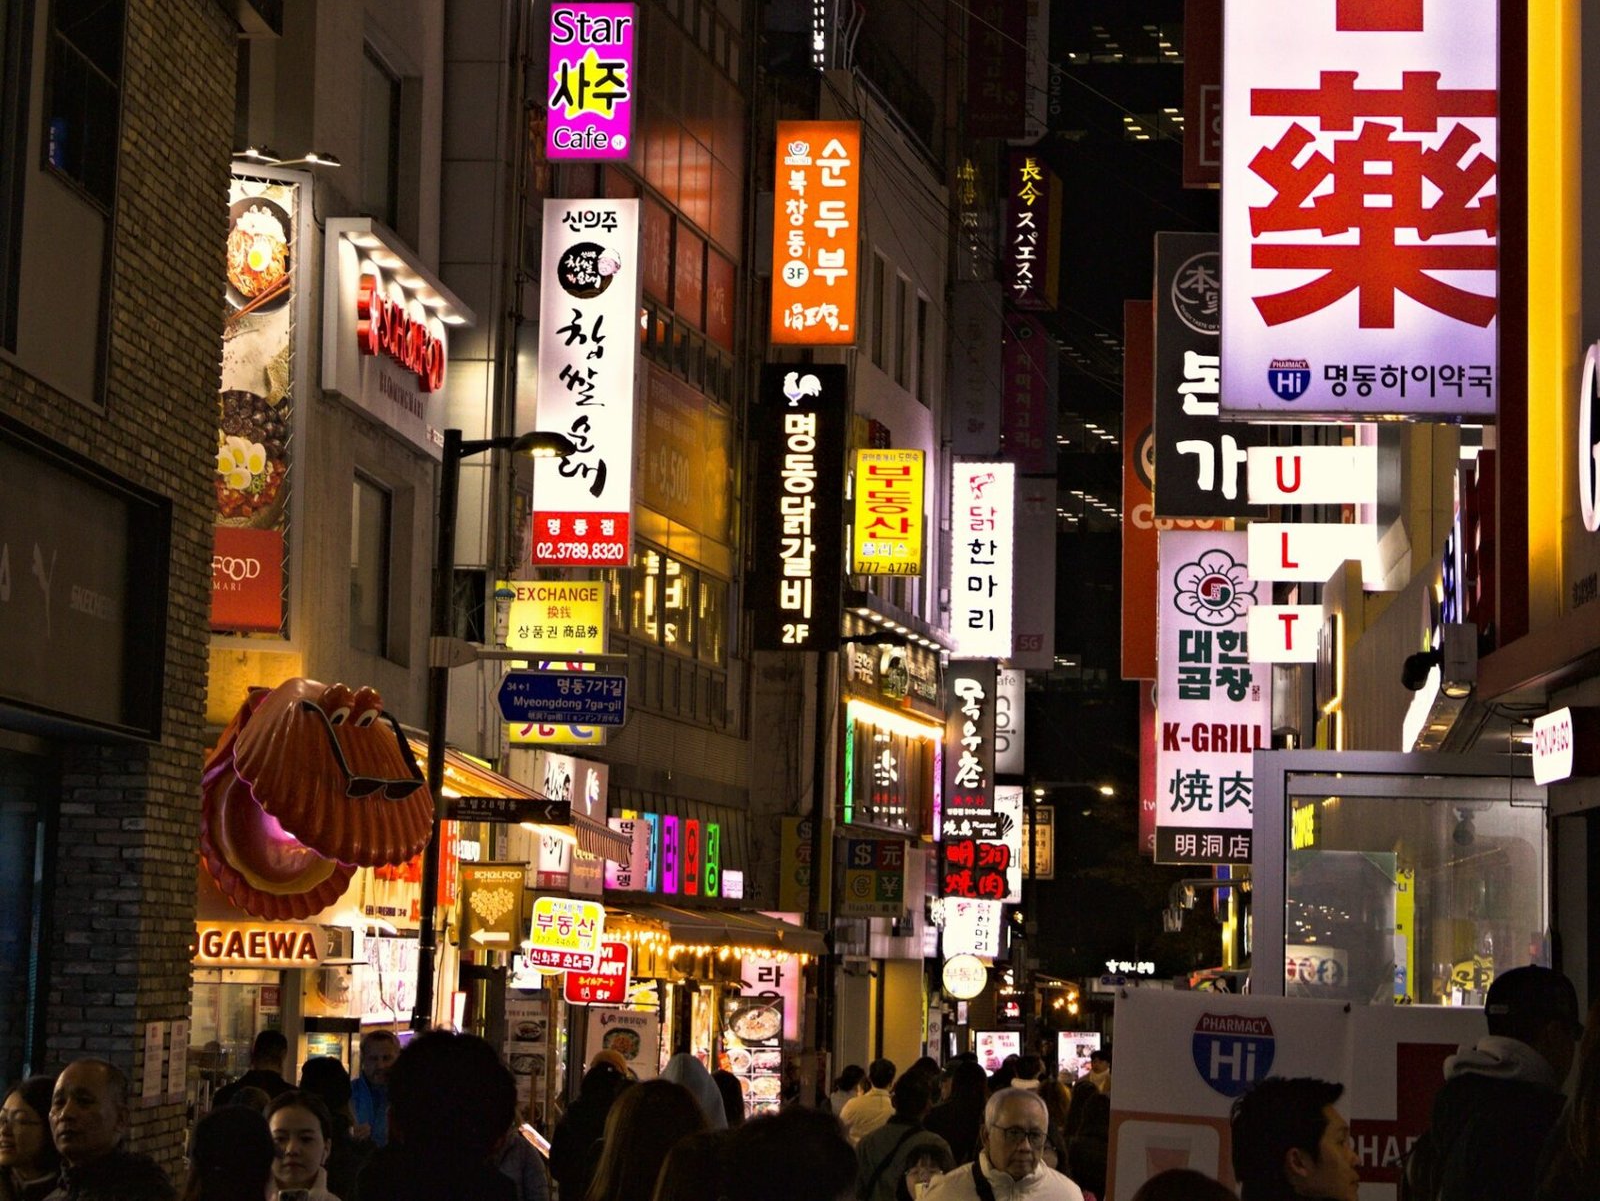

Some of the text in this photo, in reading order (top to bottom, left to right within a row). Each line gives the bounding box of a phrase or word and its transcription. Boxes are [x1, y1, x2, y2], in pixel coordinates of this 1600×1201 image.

[552, 10, 631, 44] Star
[551, 61, 628, 110] 사주
[554, 126, 608, 149] Cafe
[1017, 157, 1044, 207] 長今
[562, 210, 618, 233] 신의주
[785, 169, 809, 258] 북창동
[813, 138, 851, 287] 순두부
[787, 267, 805, 280] 3F
[1273, 361, 1307, 369] PHARMACY
[1277, 372, 1302, 393] Hi
[1323, 363, 1493, 398] 명동하이약국
[864, 465, 914, 541] 부동산
[546, 518, 615, 536] 명동점
[779, 412, 818, 619] 명동닭갈비
[536, 542, 624, 561] 02.3789.8320
[858, 562, 918, 575] 777-4778
[967, 505, 999, 632] 닭한마리
[516, 587, 598, 602] EXCHANGE
[518, 625, 598, 639] 상품권 商品券
[781, 624, 810, 644] 2F
[1019, 635, 1039, 649] 5G
[1178, 629, 1248, 665] 대한
[557, 678, 623, 697] 명동7가길
[1178, 666, 1253, 703] 곱창
[513, 696, 622, 712] Myeongdong 7ga-gil
[1163, 722, 1262, 754] K-GRILL
[1174, 834, 1250, 860] 明洞店
[537, 913, 595, 938] 부동산
[1202, 1017, 1268, 1033] PHARMACY
[1209, 1039, 1256, 1081] Hi
